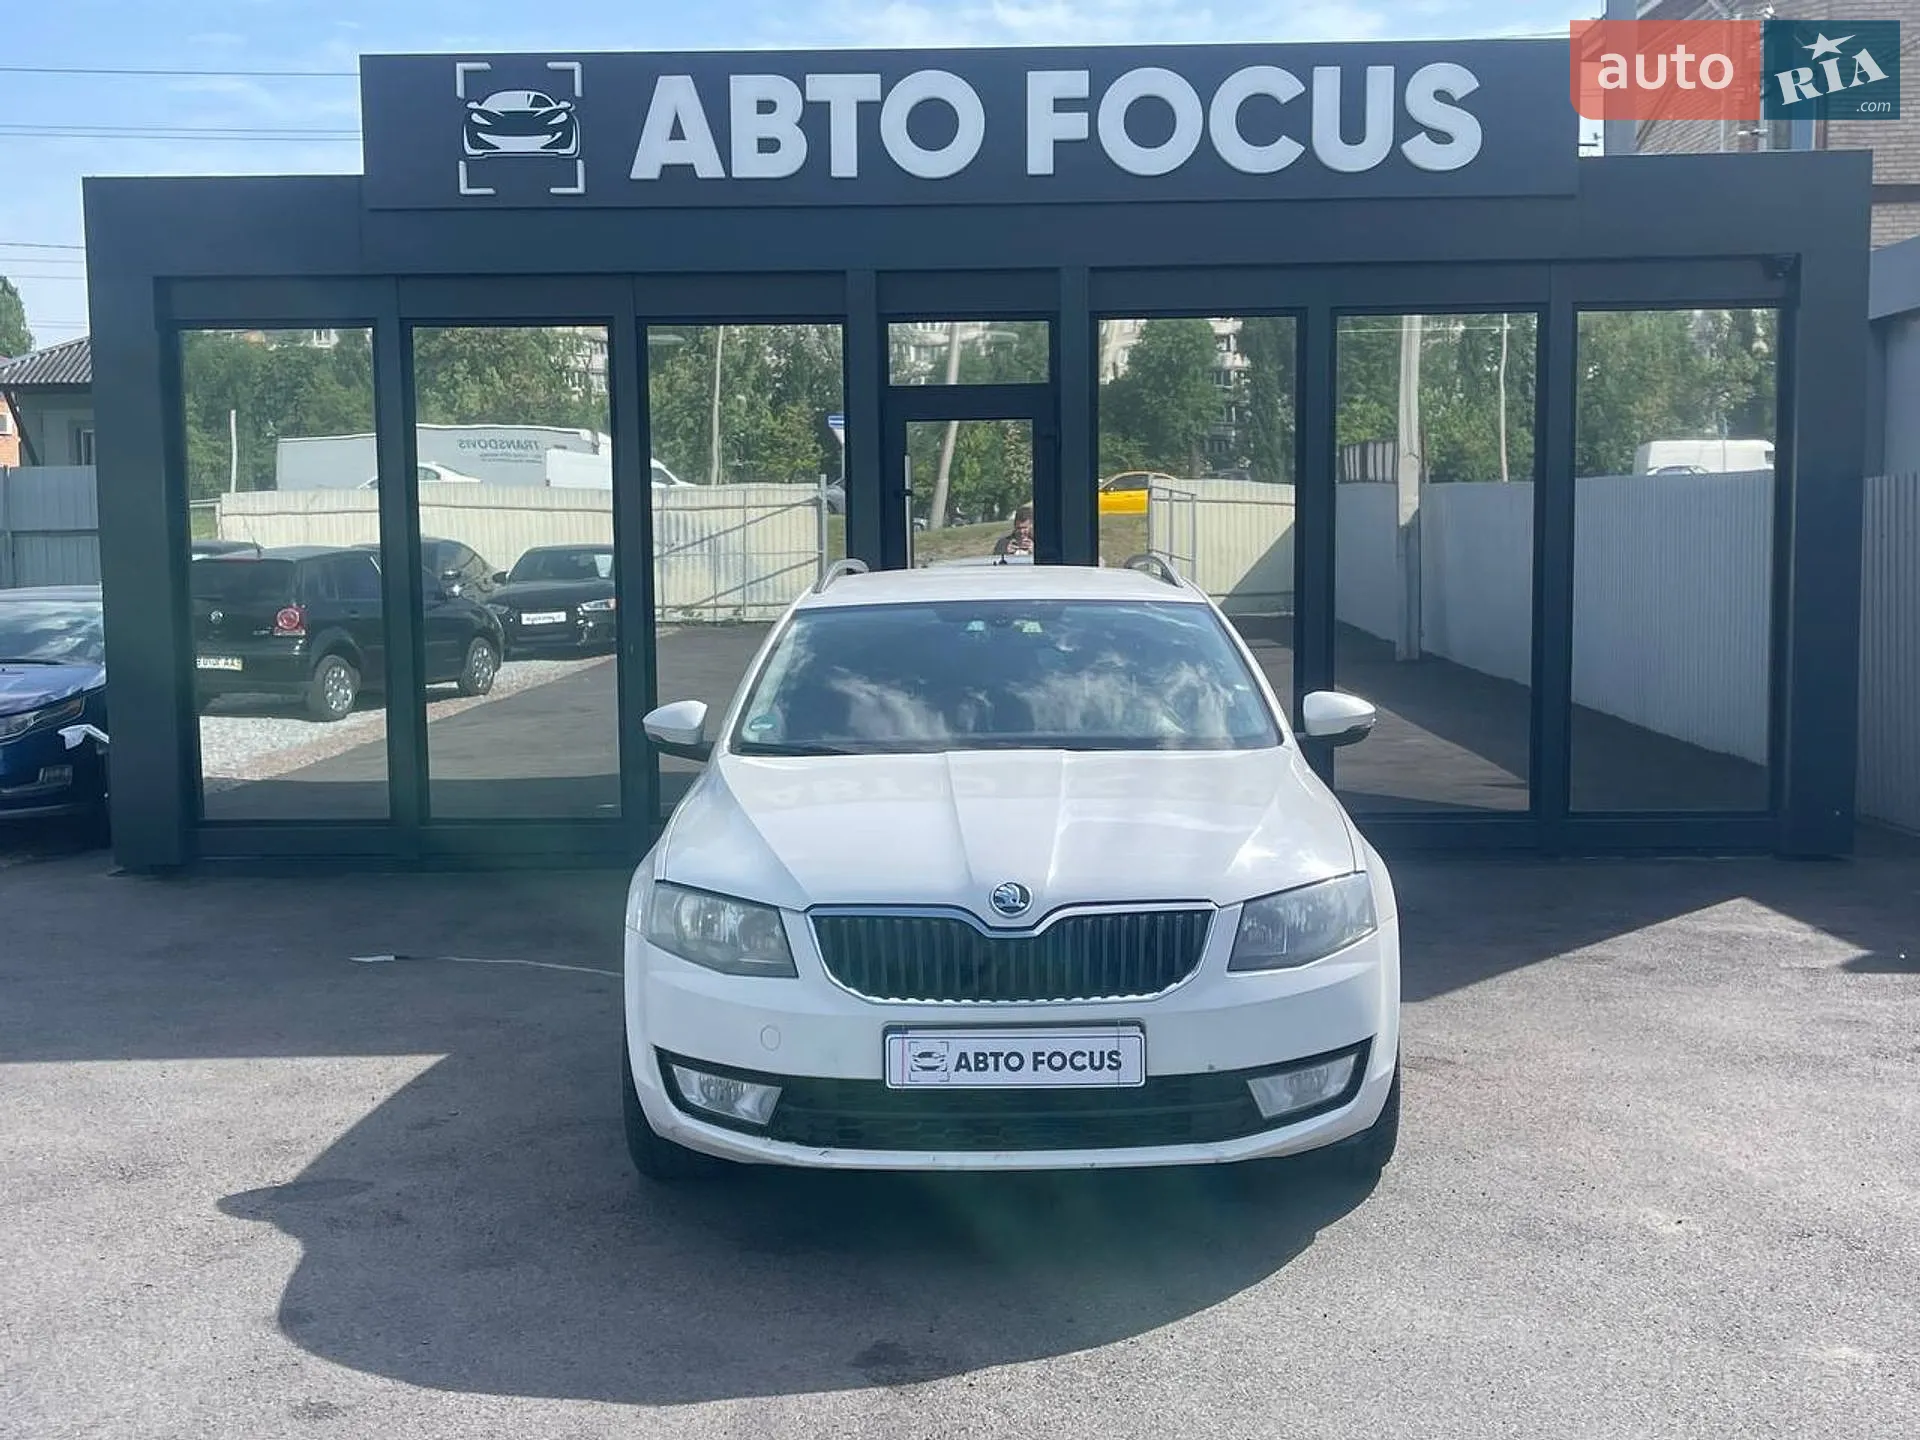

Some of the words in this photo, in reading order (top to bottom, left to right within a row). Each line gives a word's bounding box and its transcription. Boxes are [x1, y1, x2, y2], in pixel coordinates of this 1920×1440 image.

[629, 69, 986, 180] АВТО
[1026, 62, 1483, 177] FOCUS
[954, 1051, 1026, 1073] АВТО
[1032, 1050, 1123, 1072] FOCUS
